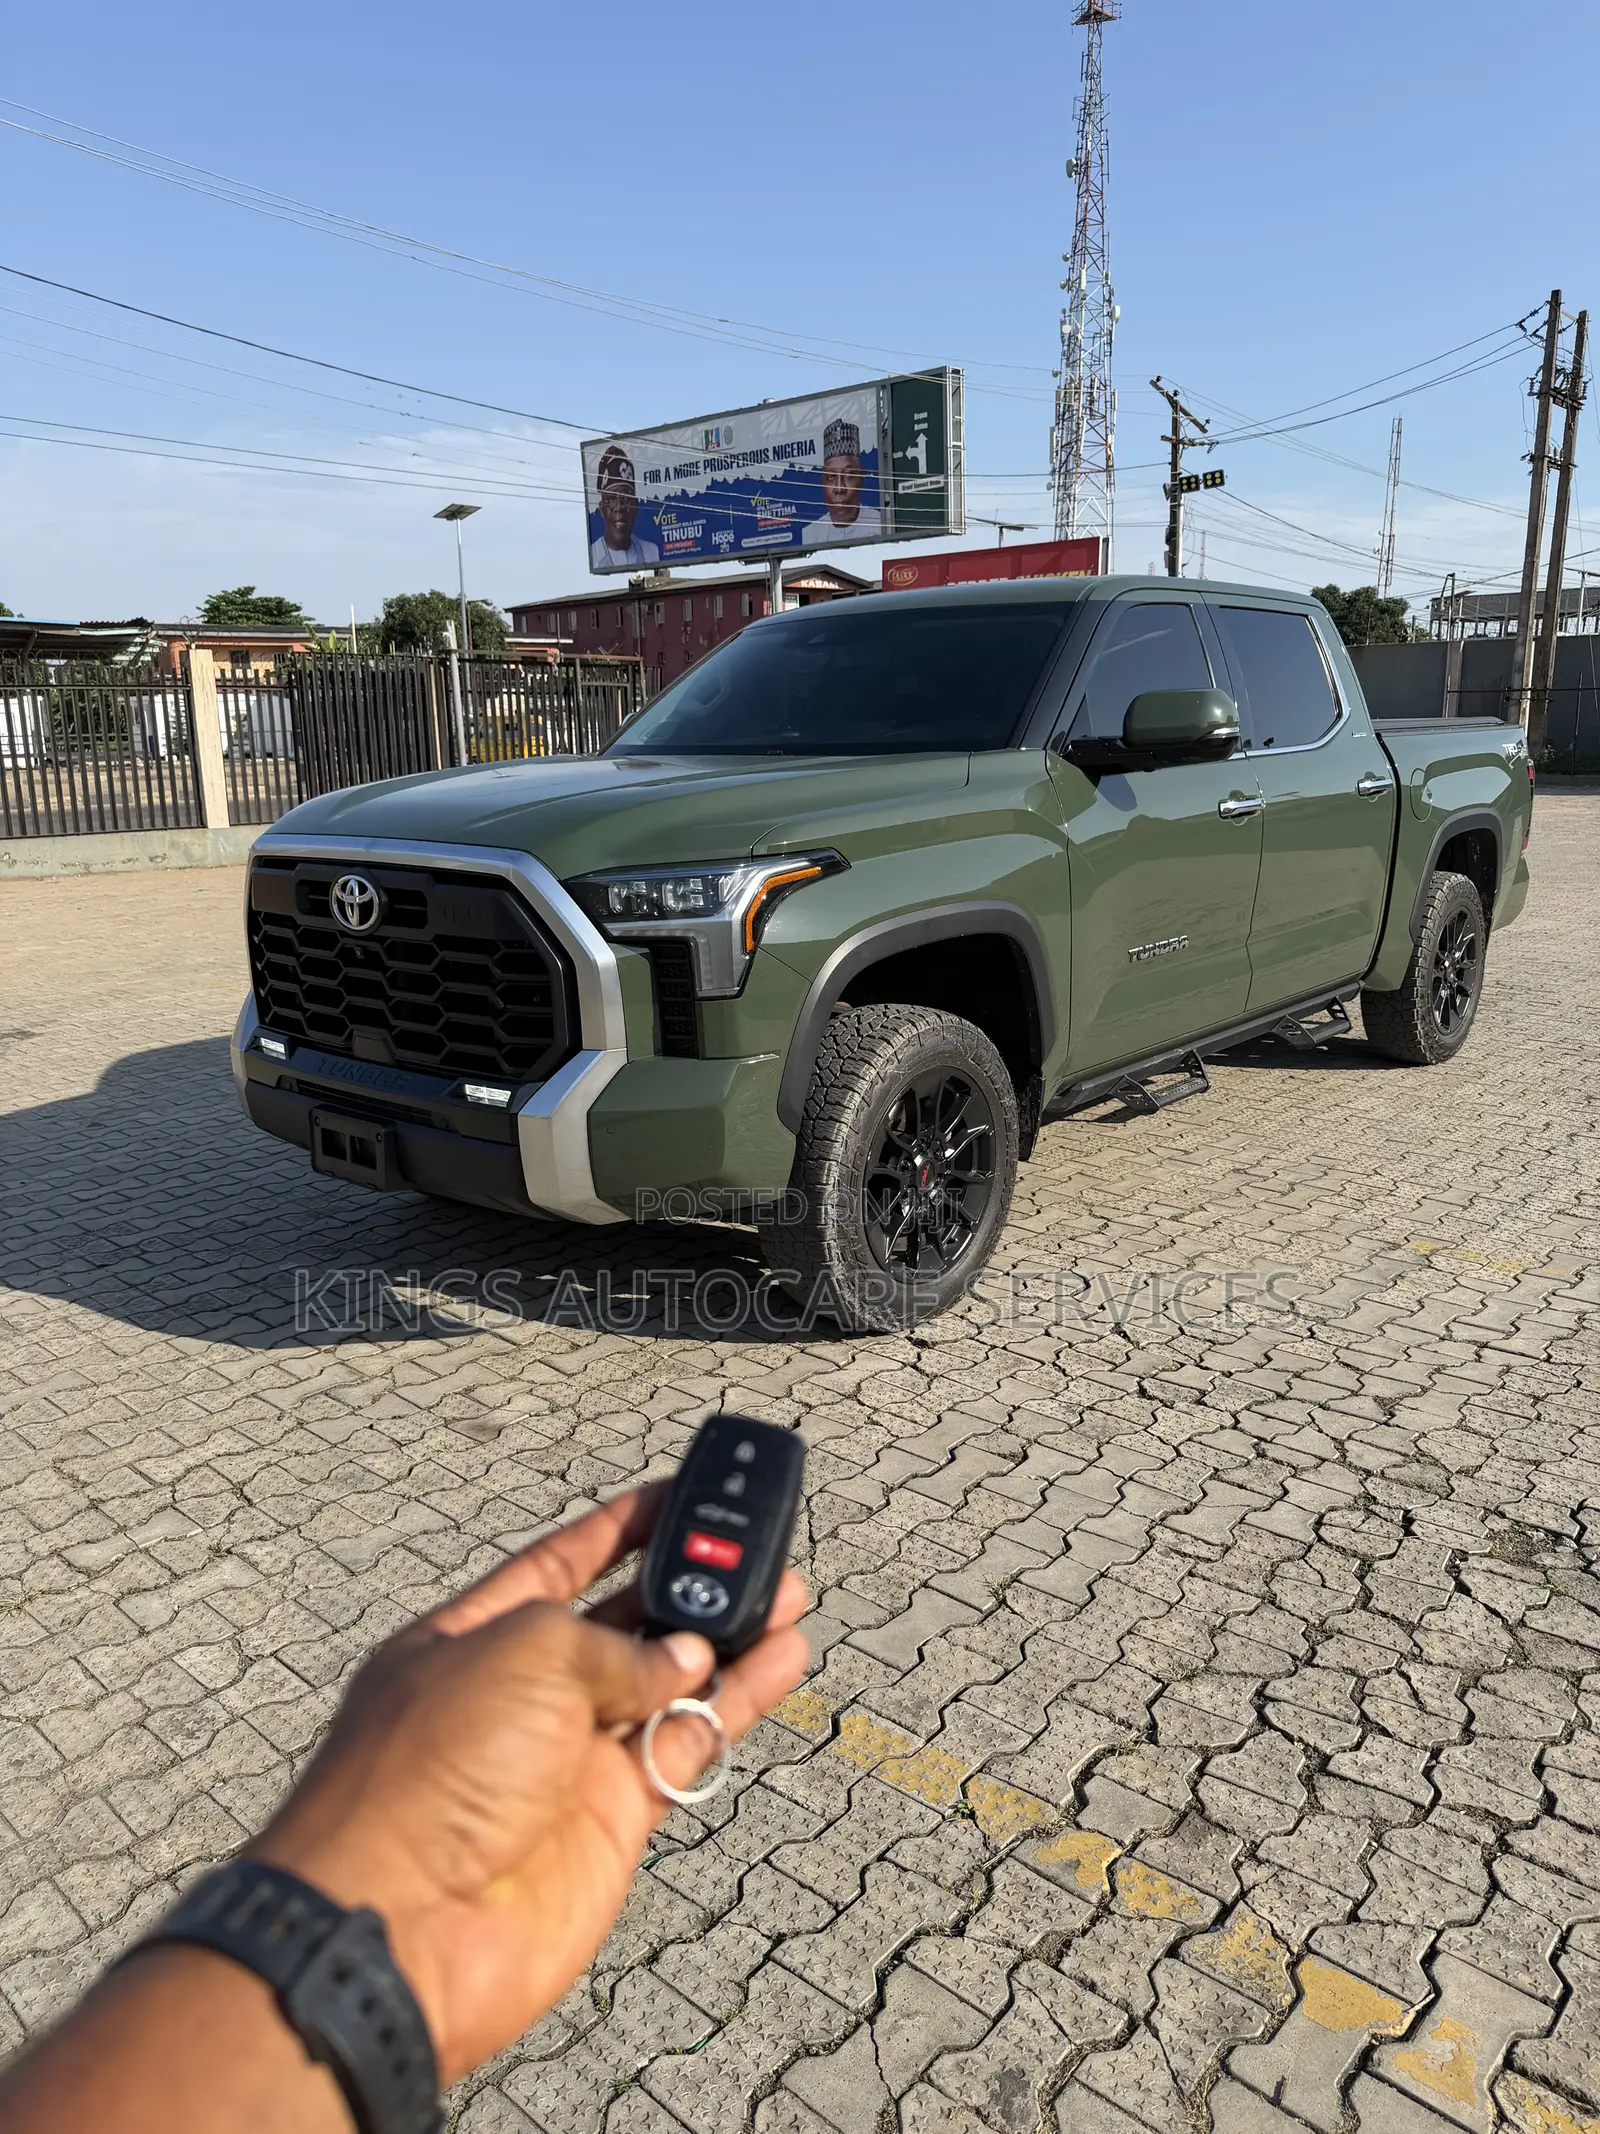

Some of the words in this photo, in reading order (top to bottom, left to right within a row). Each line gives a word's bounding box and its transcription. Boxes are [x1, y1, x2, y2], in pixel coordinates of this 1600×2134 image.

[643, 469, 662, 486] FOR
[664, 469, 671, 482] A
[674, 460, 701, 479] MORE
[703, 448, 770, 474] PROSPEROUS
[772, 439, 816, 461] NIGERIA
[756, 505, 797, 520] SHETTIMA
[661, 525, 703, 543] TINUBU
